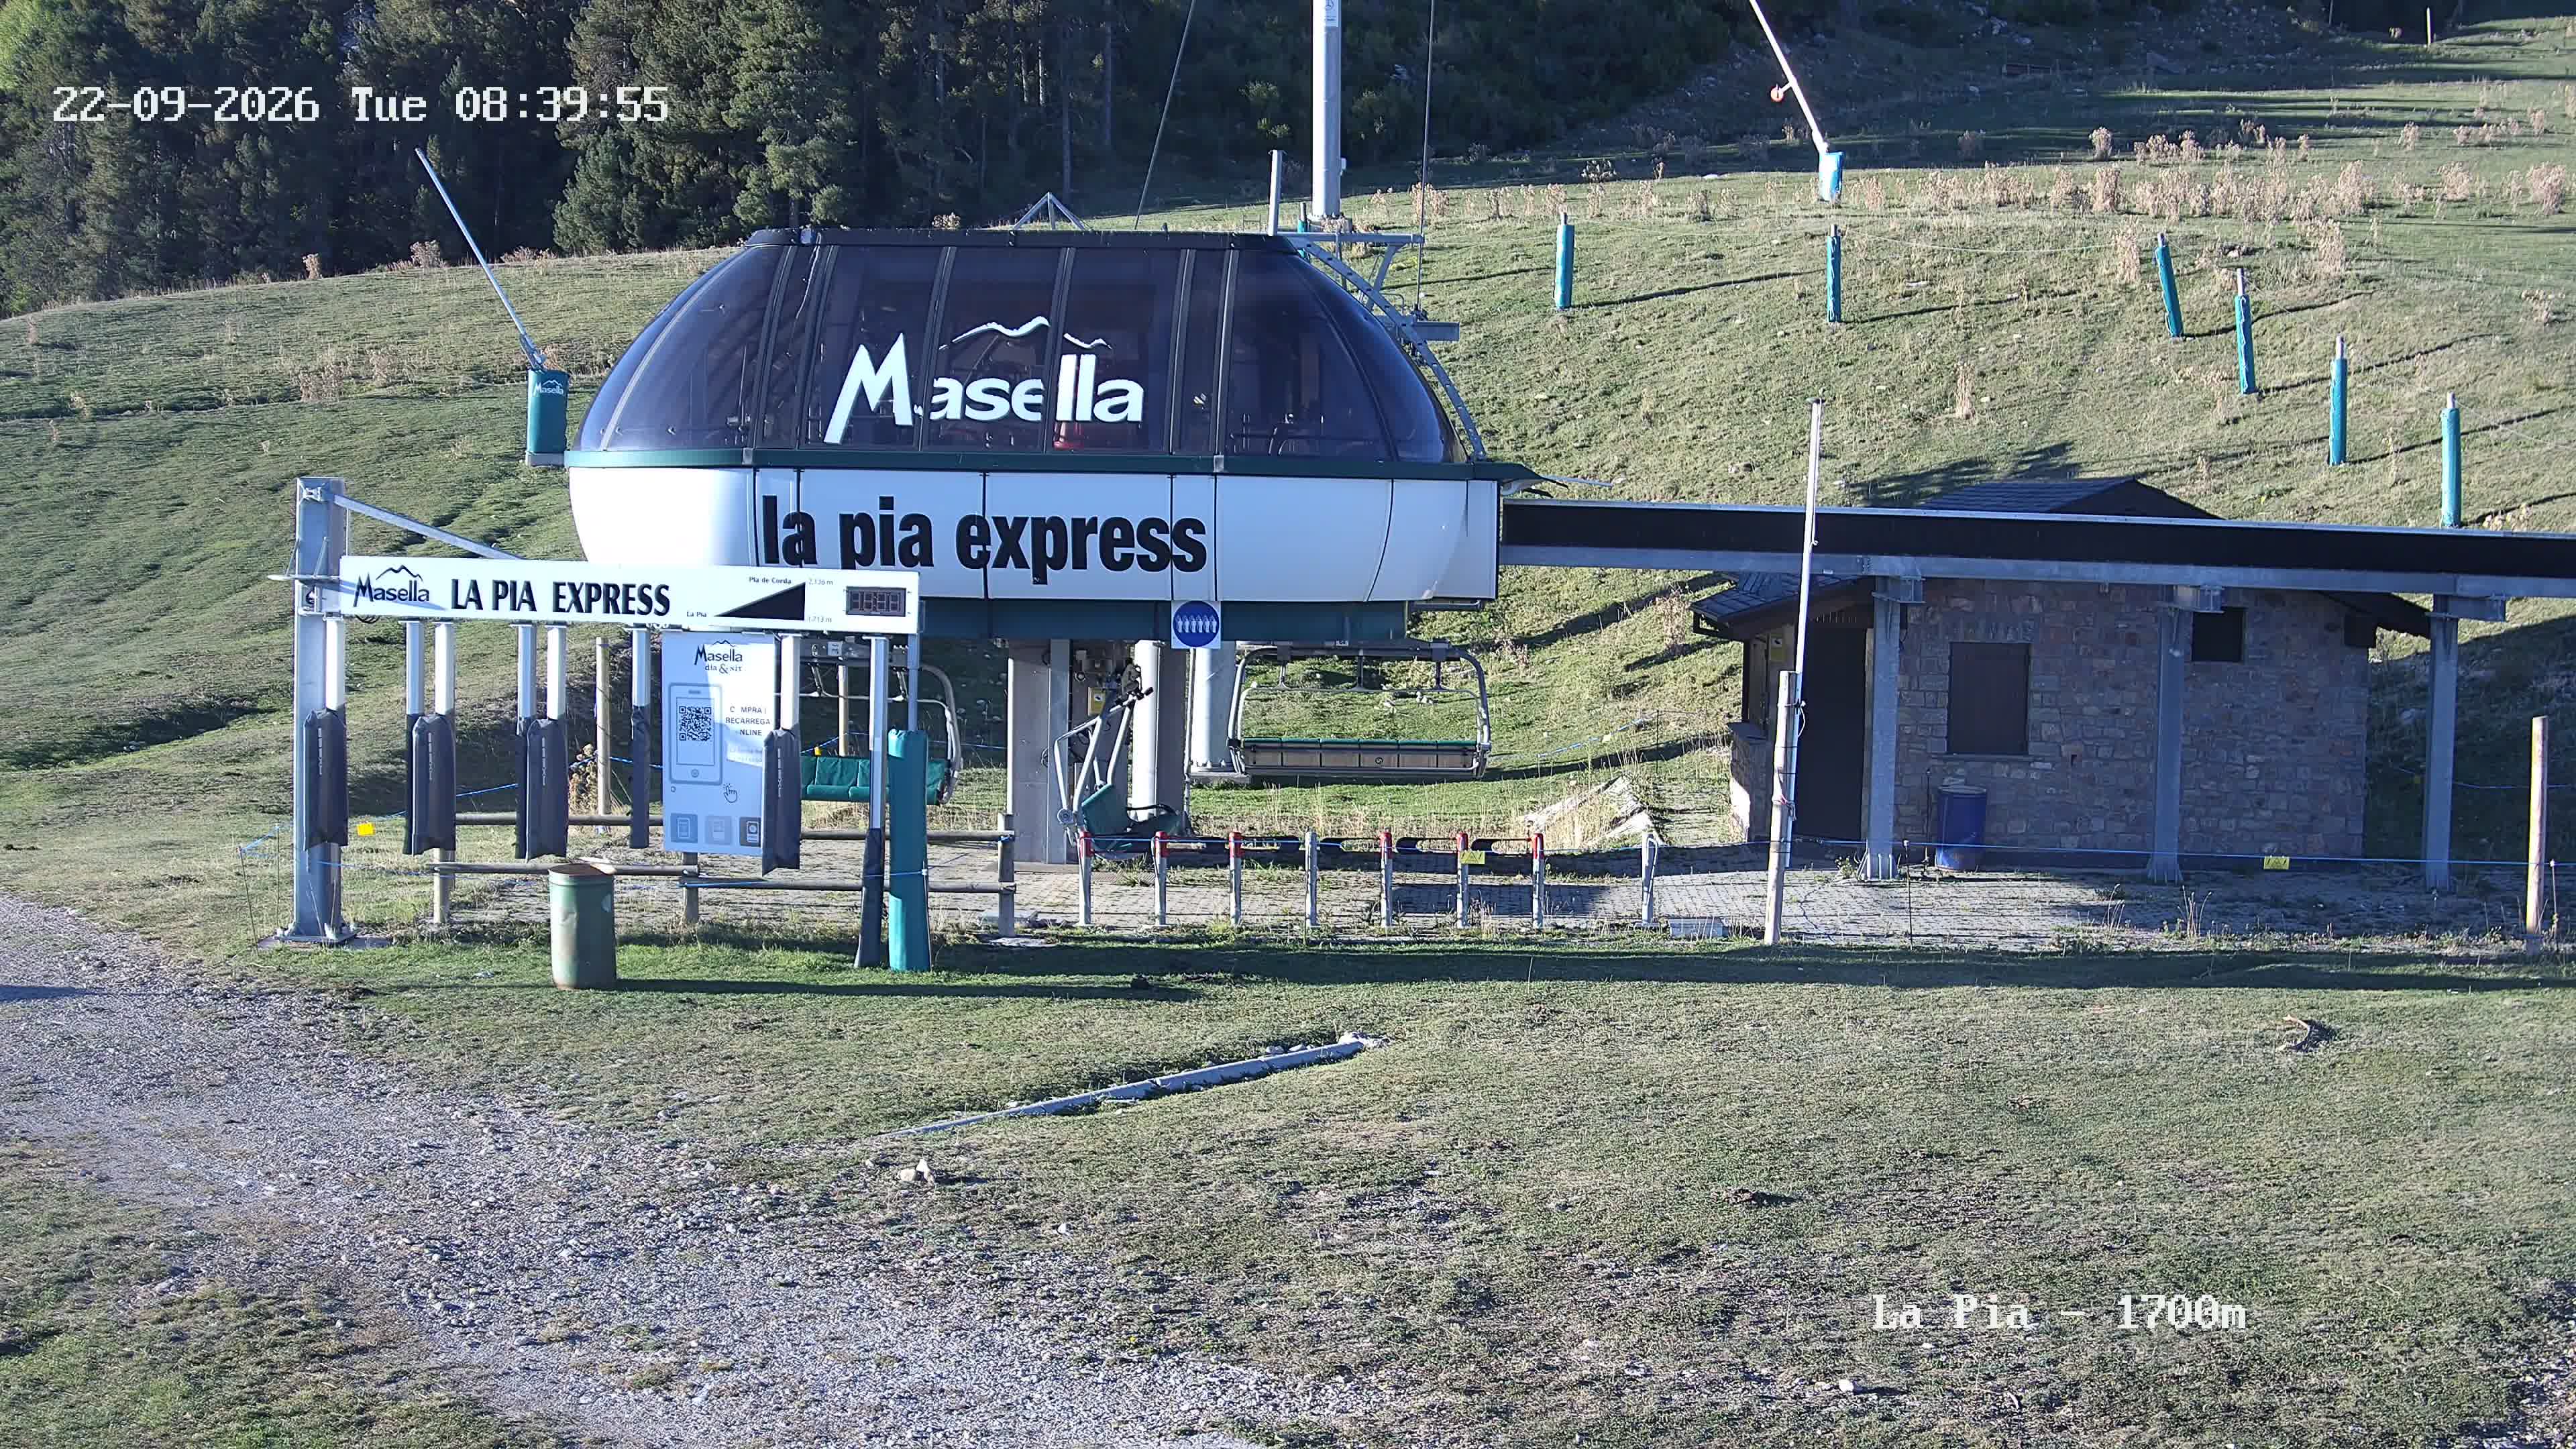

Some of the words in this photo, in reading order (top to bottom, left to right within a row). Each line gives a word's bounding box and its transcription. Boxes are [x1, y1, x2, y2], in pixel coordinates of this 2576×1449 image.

[533, 381, 564, 397] Masella
[823, 333, 1144, 443] Masella
[762, 495, 817, 566] la
[839, 496, 934, 571] pia
[956, 513, 1207, 585] express
[353, 572, 430, 608] Masella
[451, 578, 484, 610] LA
[492, 579, 537, 612] PIA
[552, 581, 670, 616] EXPRESS
[694, 643, 743, 665] Masella
[718, 663, 729, 674] &
